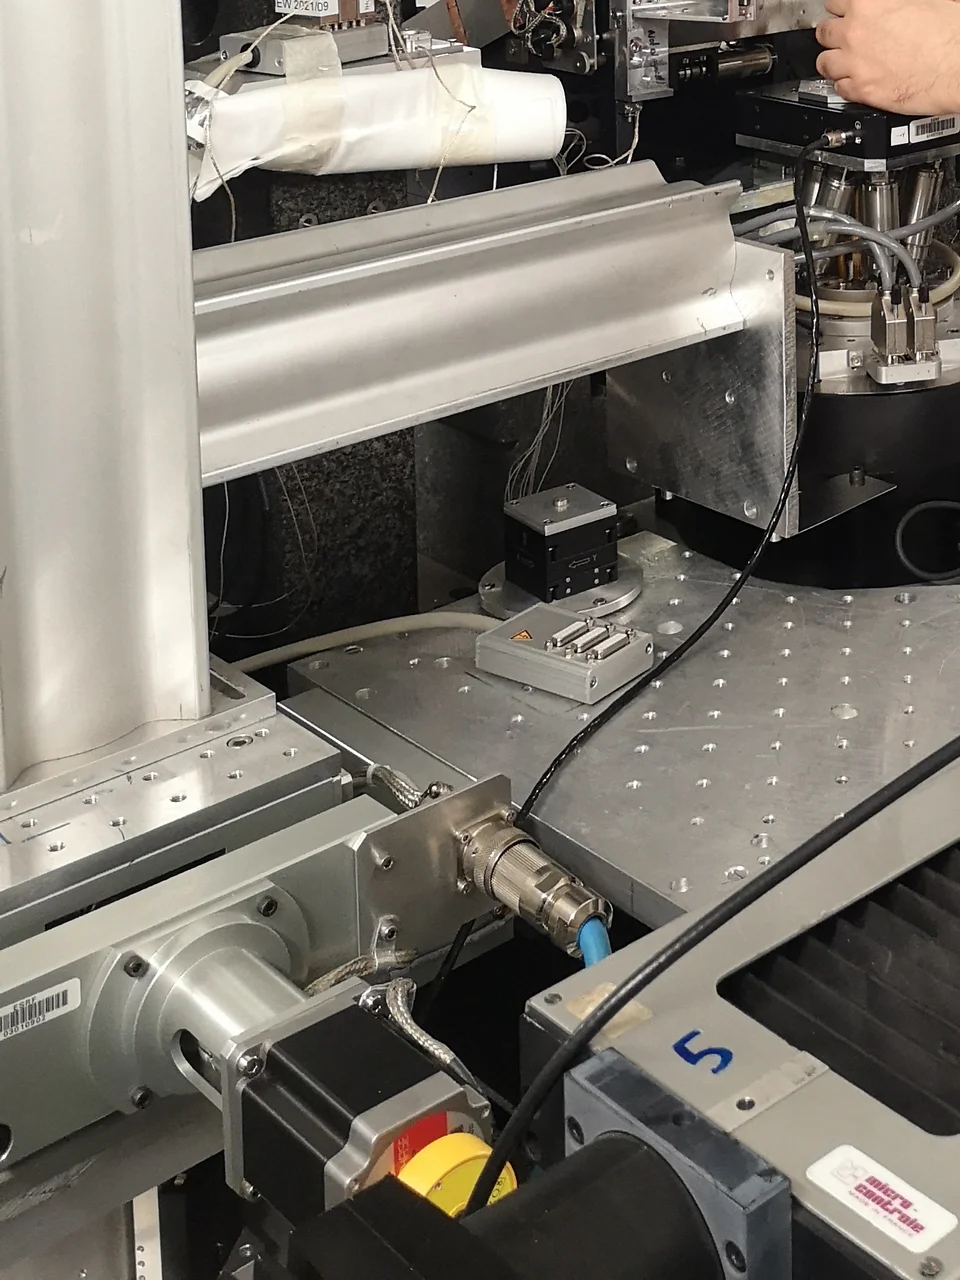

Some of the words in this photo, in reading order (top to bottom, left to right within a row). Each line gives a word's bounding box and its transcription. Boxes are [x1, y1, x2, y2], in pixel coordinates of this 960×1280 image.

[294, 0, 329, 12] 2021/09
[13, 995, 37, 1011] ESRF
[672, 1030, 734, 1075] 5
